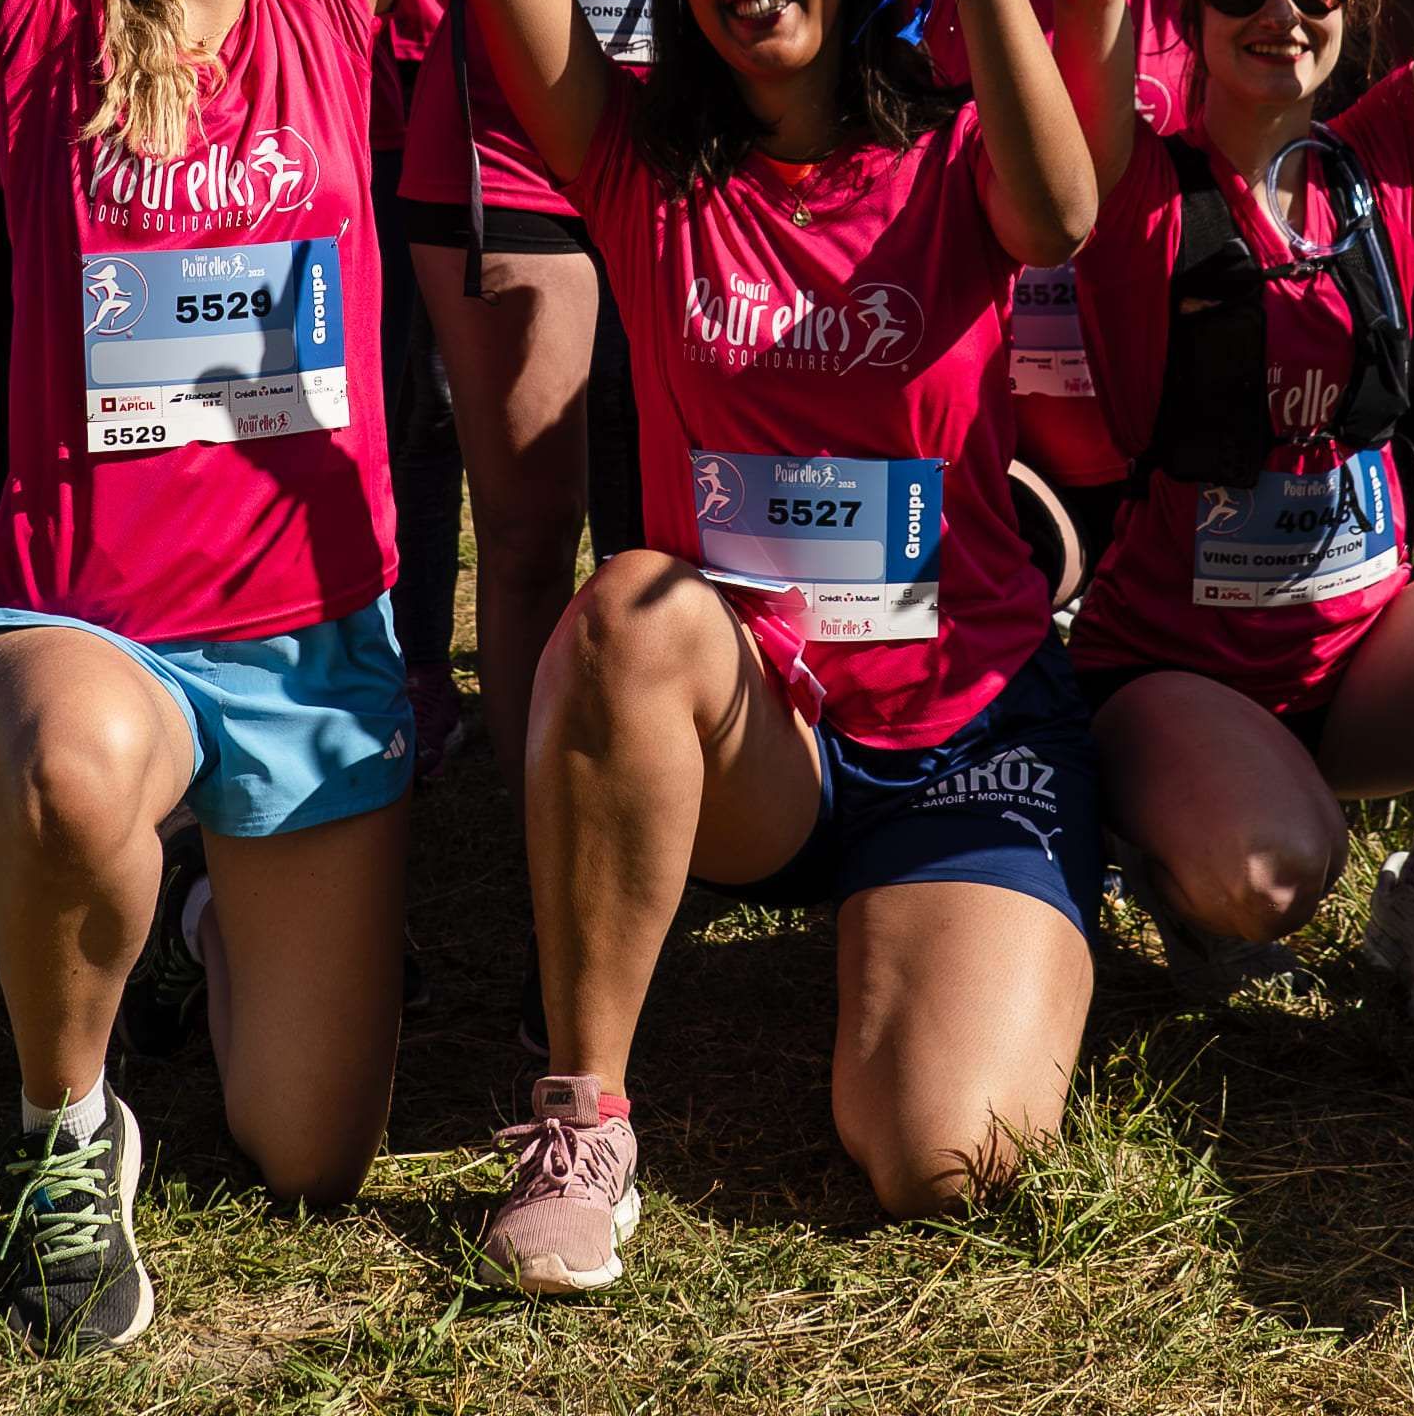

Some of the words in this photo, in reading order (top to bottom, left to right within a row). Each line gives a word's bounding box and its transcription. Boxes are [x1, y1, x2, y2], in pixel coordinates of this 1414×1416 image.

[581, 5, 653, 18] CONSTRU
[88, 201, 130, 227] TOUS
[142, 209, 254, 233] SOLIDAIRES
[181, 257, 208, 278] Pour
[208, 255, 232, 276] elles
[729, 272, 771, 302] Courir
[176, 288, 272, 324] 5529
[311, 263, 326, 345] Groupe
[728, 348, 840, 372] SOLIDAIRES
[119, 401, 156, 412] APICIL
[1283, 368, 1340, 427] elle
[103, 425, 167, 446] 5529
[774, 464, 799, 483] Pour
[800, 463, 822, 483] elles
[837, 480, 857, 489] 2025
[767, 498, 862, 528] 5527
[904, 482, 925, 559] Groupe
[1203, 551, 1247, 565] VINCI
[1252, 538, 1364, 567] CONSTRUCTION
[818, 594, 843, 602] Crédit
[855, 594, 880, 602] Mutuel
[820, 619, 842, 636] Pour
[921, 793, 967, 808] SAVOIE
[977, 792, 1015, 803] MONT
[1018, 795, 1058, 814] BLANC
